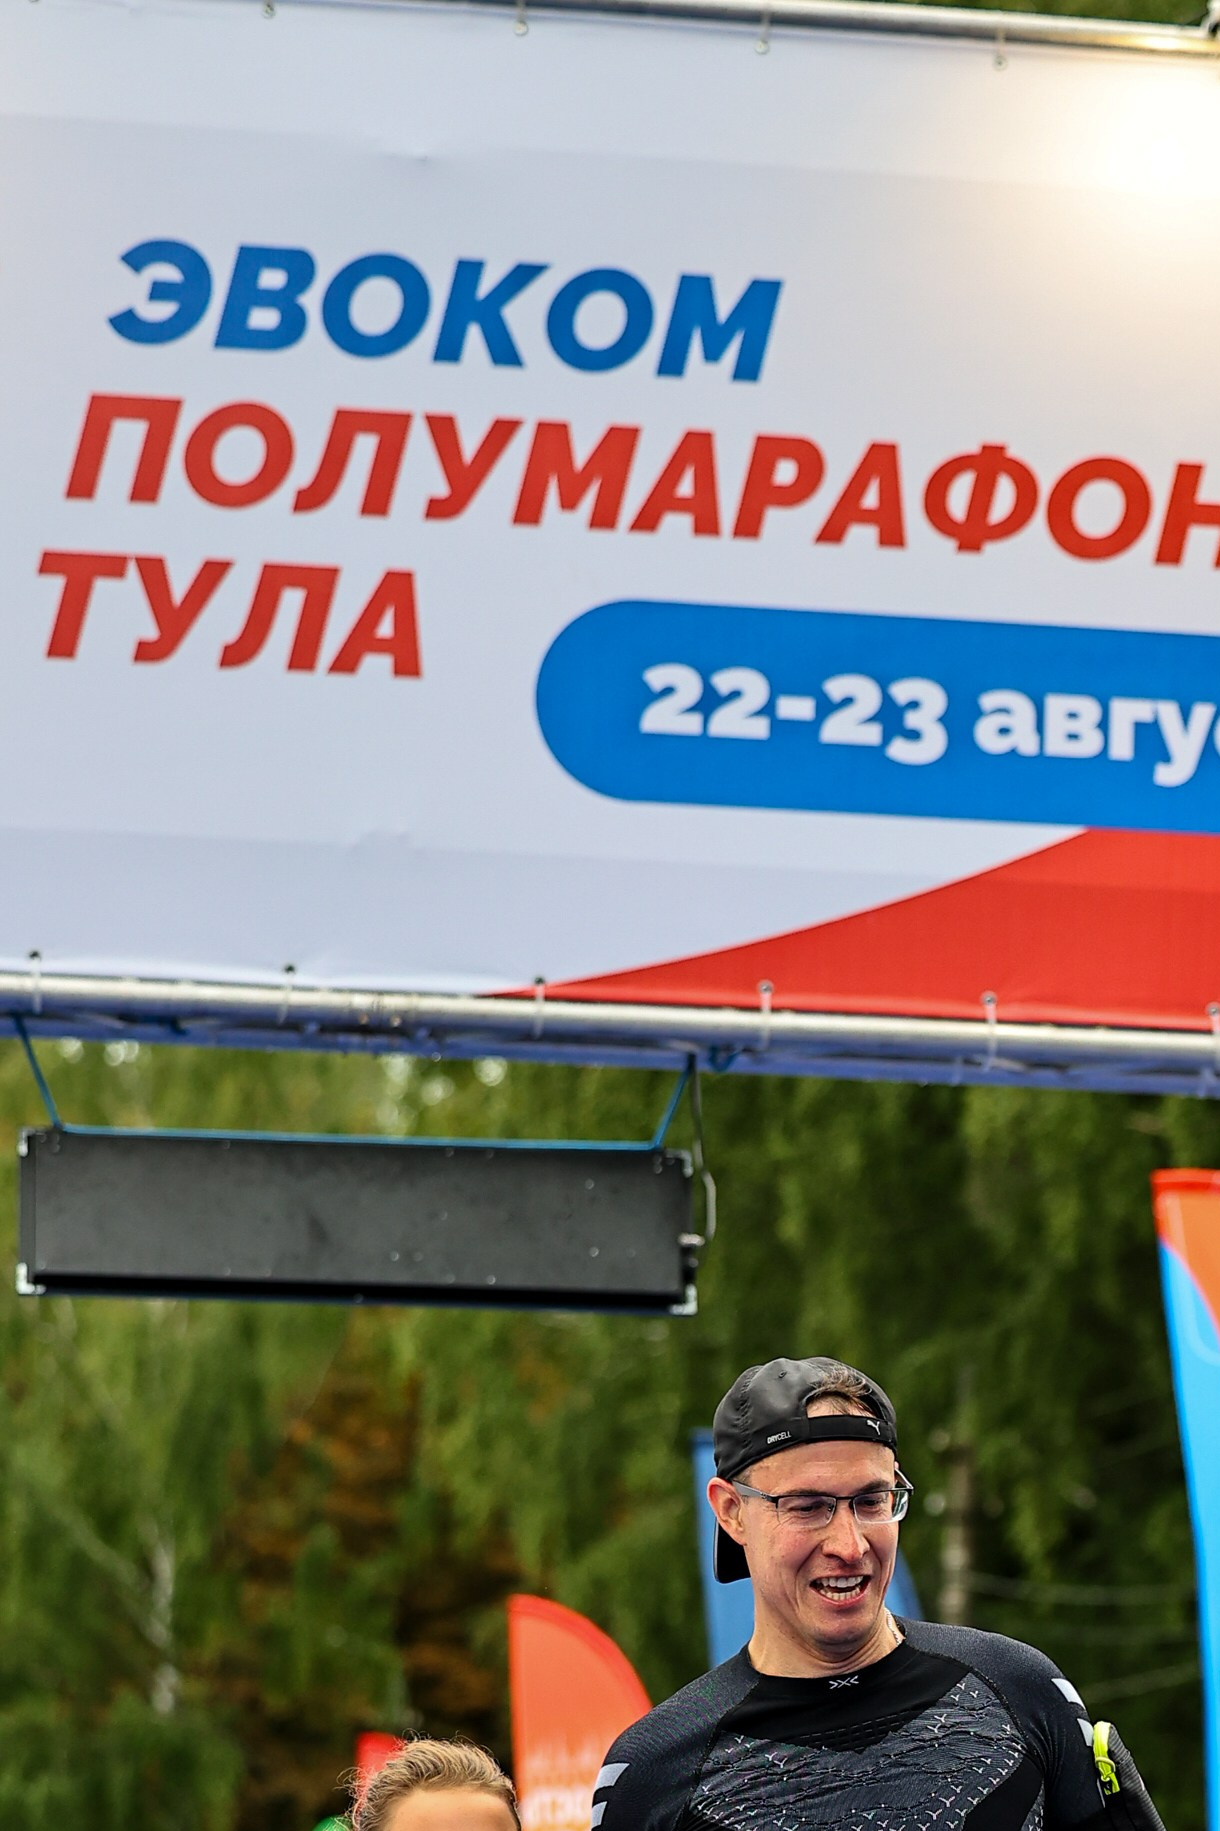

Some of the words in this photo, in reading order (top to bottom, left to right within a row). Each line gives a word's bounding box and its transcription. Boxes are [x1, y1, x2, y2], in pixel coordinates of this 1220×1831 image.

[107, 238, 784, 383] ЭВОКОМ
[37, 550, 422, 679] ТУЛА
[640, 663, 950, 765] 22-23
[767, 1431, 792, 1444] DRYCELL
